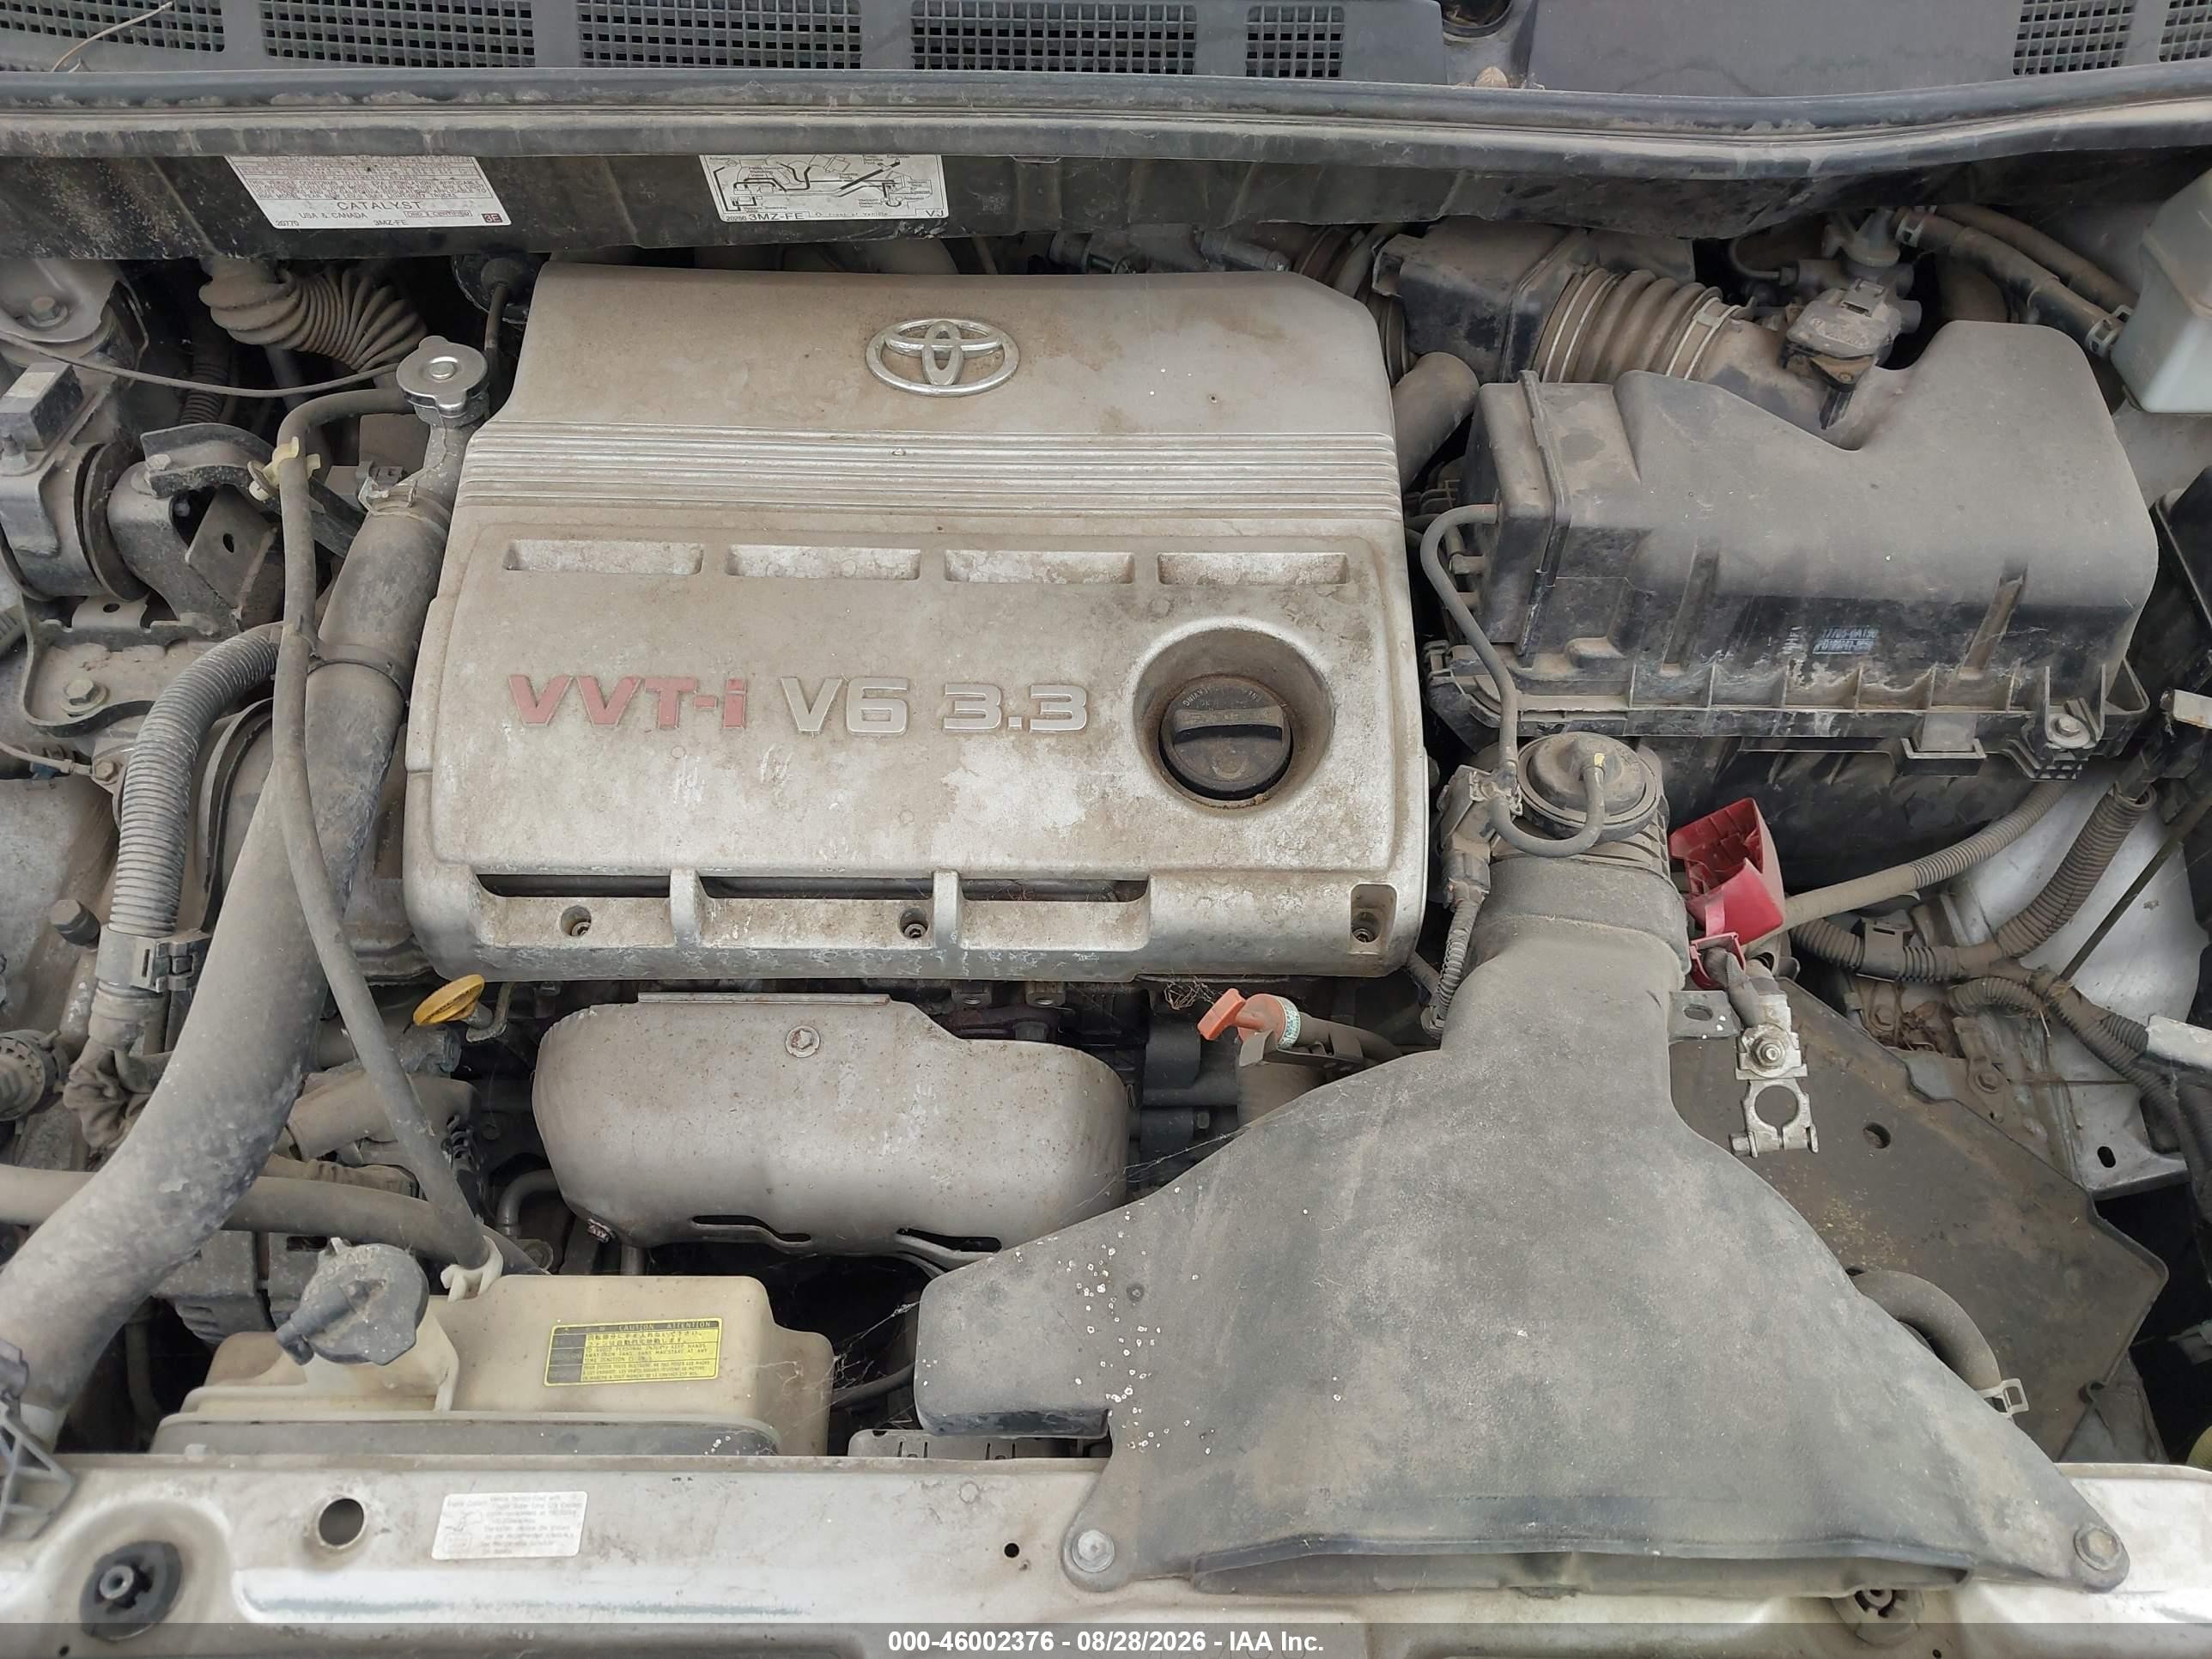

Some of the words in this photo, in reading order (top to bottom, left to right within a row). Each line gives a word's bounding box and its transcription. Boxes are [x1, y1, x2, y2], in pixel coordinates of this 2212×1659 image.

[337, 201, 422, 210] CATALYST
[507, 674, 749, 729] VVT-i
[781, 677, 909, 736] V6
[943, 684, 1089, 733] 3.3
